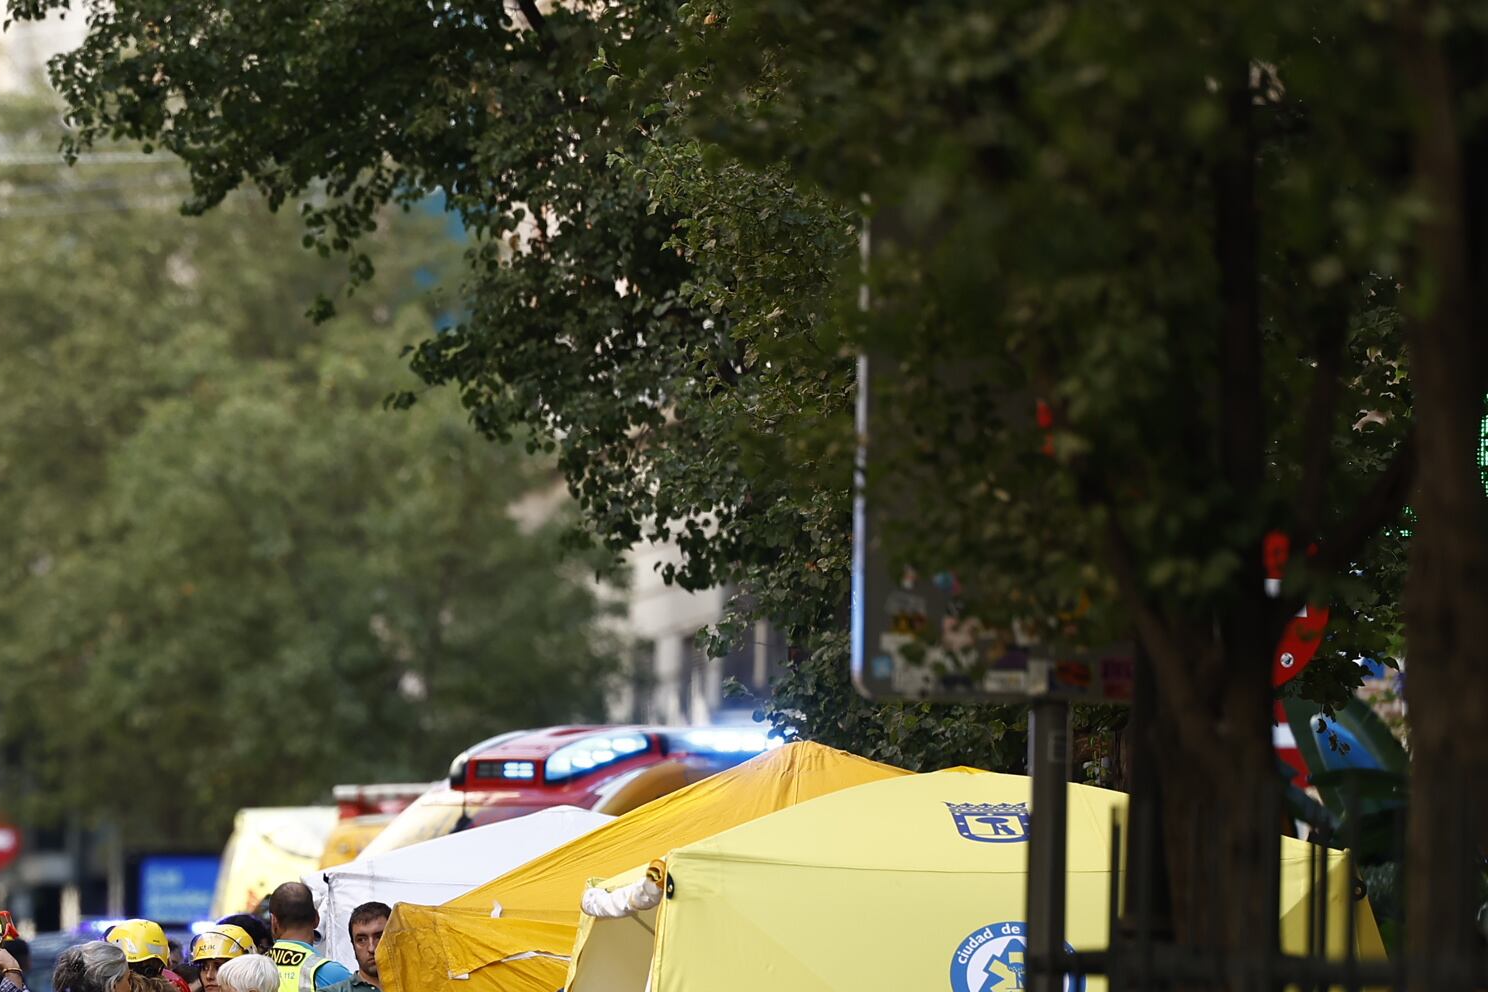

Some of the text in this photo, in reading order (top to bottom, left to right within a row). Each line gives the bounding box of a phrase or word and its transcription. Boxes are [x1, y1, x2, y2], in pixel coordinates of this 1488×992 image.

[265, 948, 304, 965] NICO
[958, 923, 1021, 965] ciudad de
